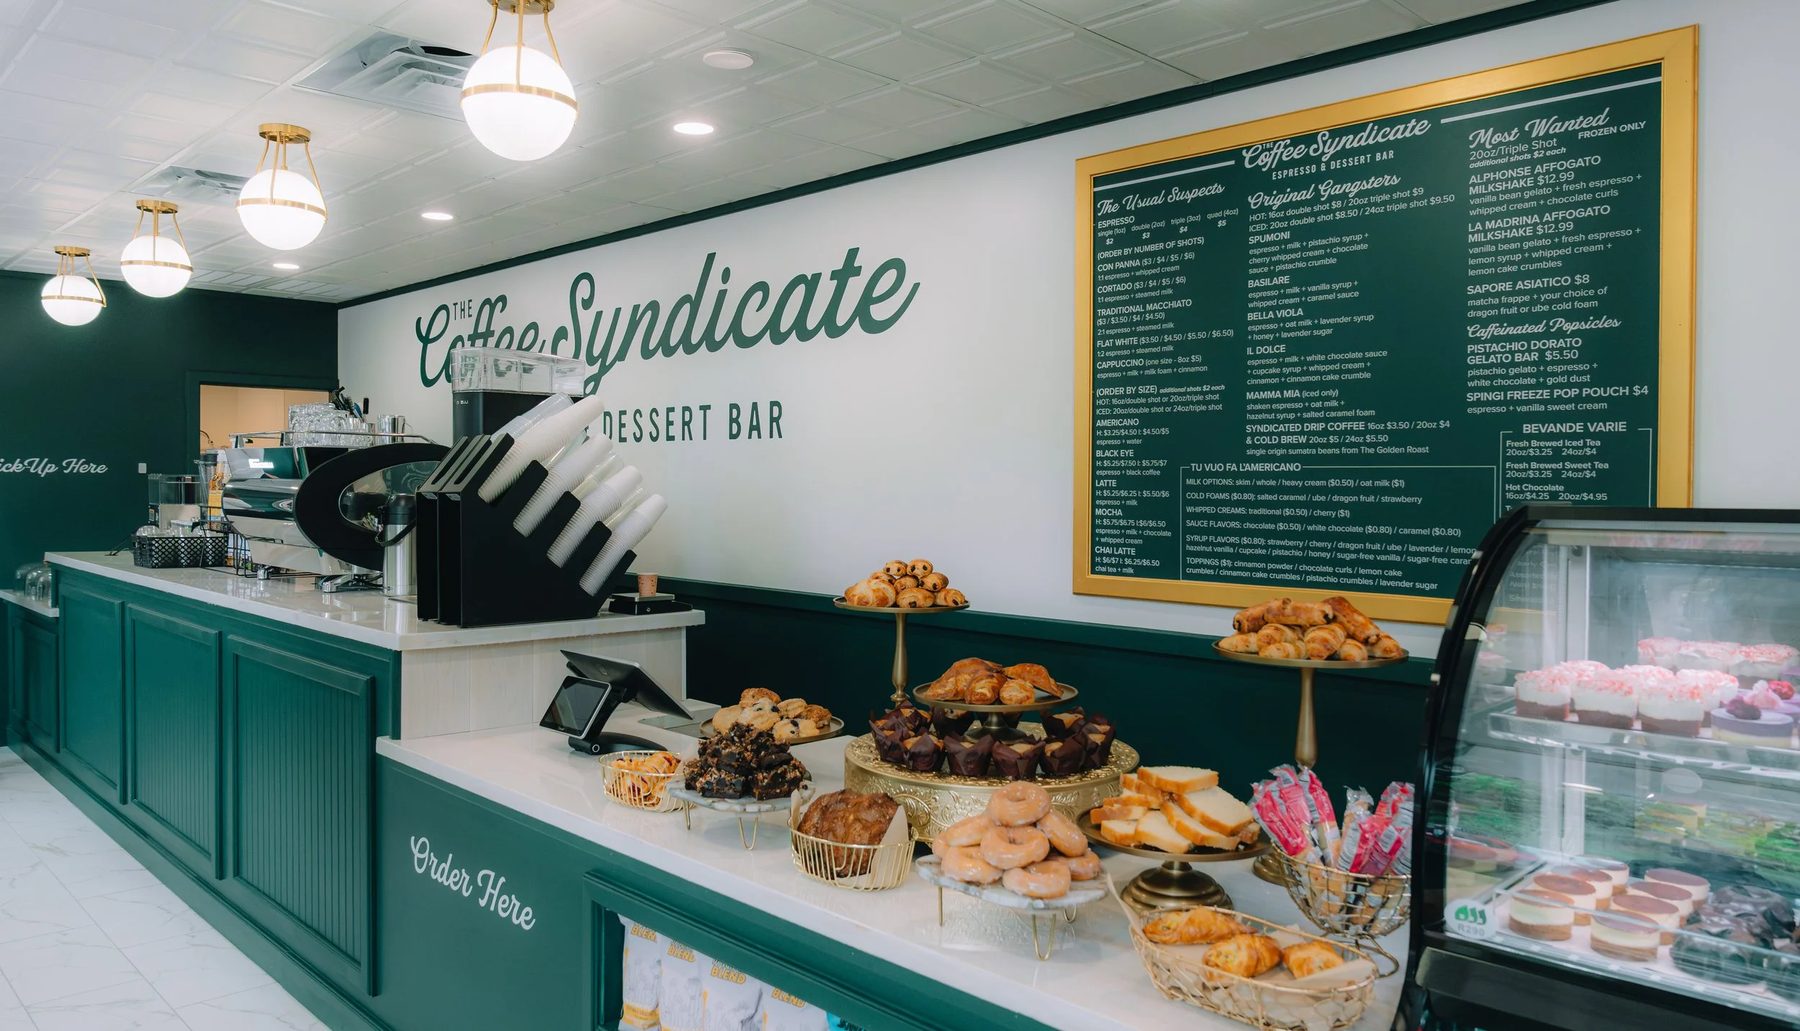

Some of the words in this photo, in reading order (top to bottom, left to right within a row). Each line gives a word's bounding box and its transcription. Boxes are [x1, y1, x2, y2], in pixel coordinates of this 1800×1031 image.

[1468, 128, 1520, 149] Most
[1524, 107, 1610, 138] Wanted
[1578, 126, 1617, 139] FROZEN
[1619, 120, 1646, 132] ONLY
[1242, 140, 1308, 172] Coffee
[1309, 118, 1431, 160] Syndicate
[1469, 143, 1528, 160] 20oz/Triple
[1531, 138, 1557, 151] Shot
[1272, 164, 1316, 180] ESPRESSO
[1320, 162, 1326, 171] &
[1330, 154, 1371, 169] DESSERT
[1375, 150, 1394, 161] BAR
[1469, 156, 1508, 168] additional
[1509, 153, 1531, 162] shots
[1532, 150, 1544, 158] $2
[1545, 146, 1566, 156] each
[1469, 166, 1531, 184] ALPHONSE
[1534, 155, 1601, 173] AFFOGATO
[1469, 177, 1534, 195] MILKSHAKE
[1537, 171, 1574, 185] $12.99
[1097, 199, 1120, 216] The
[1122, 190, 1165, 210] Usual
[1167, 183, 1224, 202] Suspects
[1248, 184, 1316, 210] Original
[1318, 174, 1401, 201] Gangsters
[1098, 215, 1135, 228] ESPRESSO
[1217, 219, 1226, 228] $5
[1468, 222, 1483, 232] LA
[1485, 214, 1539, 229] MADRINA
[1542, 205, 1610, 222] AFFOGATO
[1248, 231, 1290, 244] SPUMONI
[1468, 226, 1533, 242] MILKSHAKE
[1536, 221, 1573, 234] $12.99
[1097, 249, 1122, 260] (ORDER
[1123, 247, 1133, 255] BY
[1134, 242, 1164, 253] NUMBER
[1165, 240, 1176, 249] OF
[1177, 236, 1204, 247] SHOTS)
[1468, 267, 1495, 276] lemon
[1496, 264, 1518, 273] cake
[1520, 260, 1562, 270] crumbles
[1248, 275, 1290, 288] BASILARE
[1467, 281, 1512, 294] SAPORE
[1515, 276, 1571, 290] ASIATICO
[1574, 274, 1590, 285] $8
[452, 299, 473, 321] THE
[1098, 304, 1144, 316] TRADITIONAL
[1146, 298, 1192, 310] MACCHIATO
[1247, 310, 1274, 320] BELLA
[1275, 308, 1303, 318] VIOLA
[1467, 309, 1498, 318] dragon
[1500, 306, 1517, 314] fruit
[1531, 304, 1549, 312] ube
[1551, 301, 1571, 310] cold
[1574, 300, 1598, 308] foam
[551, 247, 920, 396] Syndicate
[1467, 320, 1546, 340] Caffeinated
[1550, 316, 1622, 332] Popsicles
[1246, 347, 1254, 355] IL
[1256, 344, 1286, 354] DOLCE
[1467, 341, 1527, 353] PISTACHIO
[1530, 337, 1582, 349] DORATO
[1467, 353, 1512, 364] GELATO
[1514, 351, 1538, 362] BAR
[1545, 349, 1578, 361] $5.50
[1096, 387, 1124, 397] (ORDER
[1126, 386, 1136, 394] BY
[1138, 385, 1157, 394] SIZE)
[1246, 390, 1281, 399] MAMMA
[1283, 389, 1300, 398] MIA
[1302, 389, 1319, 398] (iced
[1320, 388, 1338, 397] only)
[1466, 391, 1504, 401] SPINGI
[1506, 389, 1550, 400] FREEZE
[1553, 388, 1579, 398] POP
[1582, 386, 1629, 397] POUCH
[1632, 385, 1648, 396] $4
[603, 403, 712, 443] DESSERT
[728, 400, 784, 439] BAR
[1096, 418, 1139, 426] AMERICANO
[1246, 423, 1302, 432] SYNDICATED
[1303, 422, 1325, 431] DRIP
[1327, 421, 1365, 430] COFFEE
[1367, 422, 1385, 430] 16oz
[1386, 421, 1410, 429] $3.50
[1416, 420, 1437, 428] 20oz
[1438, 419, 1450, 428] $4
[1522, 422, 1584, 433] BEVANDE
[1587, 421, 1626, 432] VARIE
[1246, 448, 1266, 456] single
[1267, 448, 1287, 456] origin
[1341, 446, 1358, 454] from
[1360, 446, 1375, 454] The
[1376, 446, 1405, 454] Golden
[1406, 445, 1429, 453] Roast
[1530, 439, 1563, 447] Brewed
[1585, 438, 1601, 446] Tea
[1096, 449, 1118, 457] BLACK
[1120, 449, 1134, 457] EYE
[1506, 448, 1552, 456] 20oz/$3.25
[1562, 447, 1596, 455] 24oz/$4
[0, 458, 58, 478] ick-Up
[62, 458, 108, 474] Here
[1190, 463, 1202, 471] TU
[1204, 463, 1224, 471] VUO
[1226, 463, 1238, 471] FA
[1239, 462, 1301, 471] L'AMERICANO
[1505, 461, 1528, 469] Fresh
[1530, 461, 1563, 469] Brewed
[1564, 461, 1591, 469] Sweet
[1593, 461, 1609, 469] Tea
[1506, 470, 1552, 478] 20oz/$3.25
[1561, 470, 1596, 478] 24oz/$4
[1095, 479, 1117, 487] LATTE
[1522, 483, 1564, 491] Chocolate
[1505, 492, 1549, 500] 16oz/$4.25
[1558, 492, 1607, 502] 20oz/$4.95
[1095, 508, 1122, 516] MOCHA
[1094, 546, 1112, 554] CHAI
[1113, 547, 1136, 555] LATTE
[410, 836, 473, 897] Order
[477, 869, 536, 931] Here
[710, 965, 747, 985] BLEND
